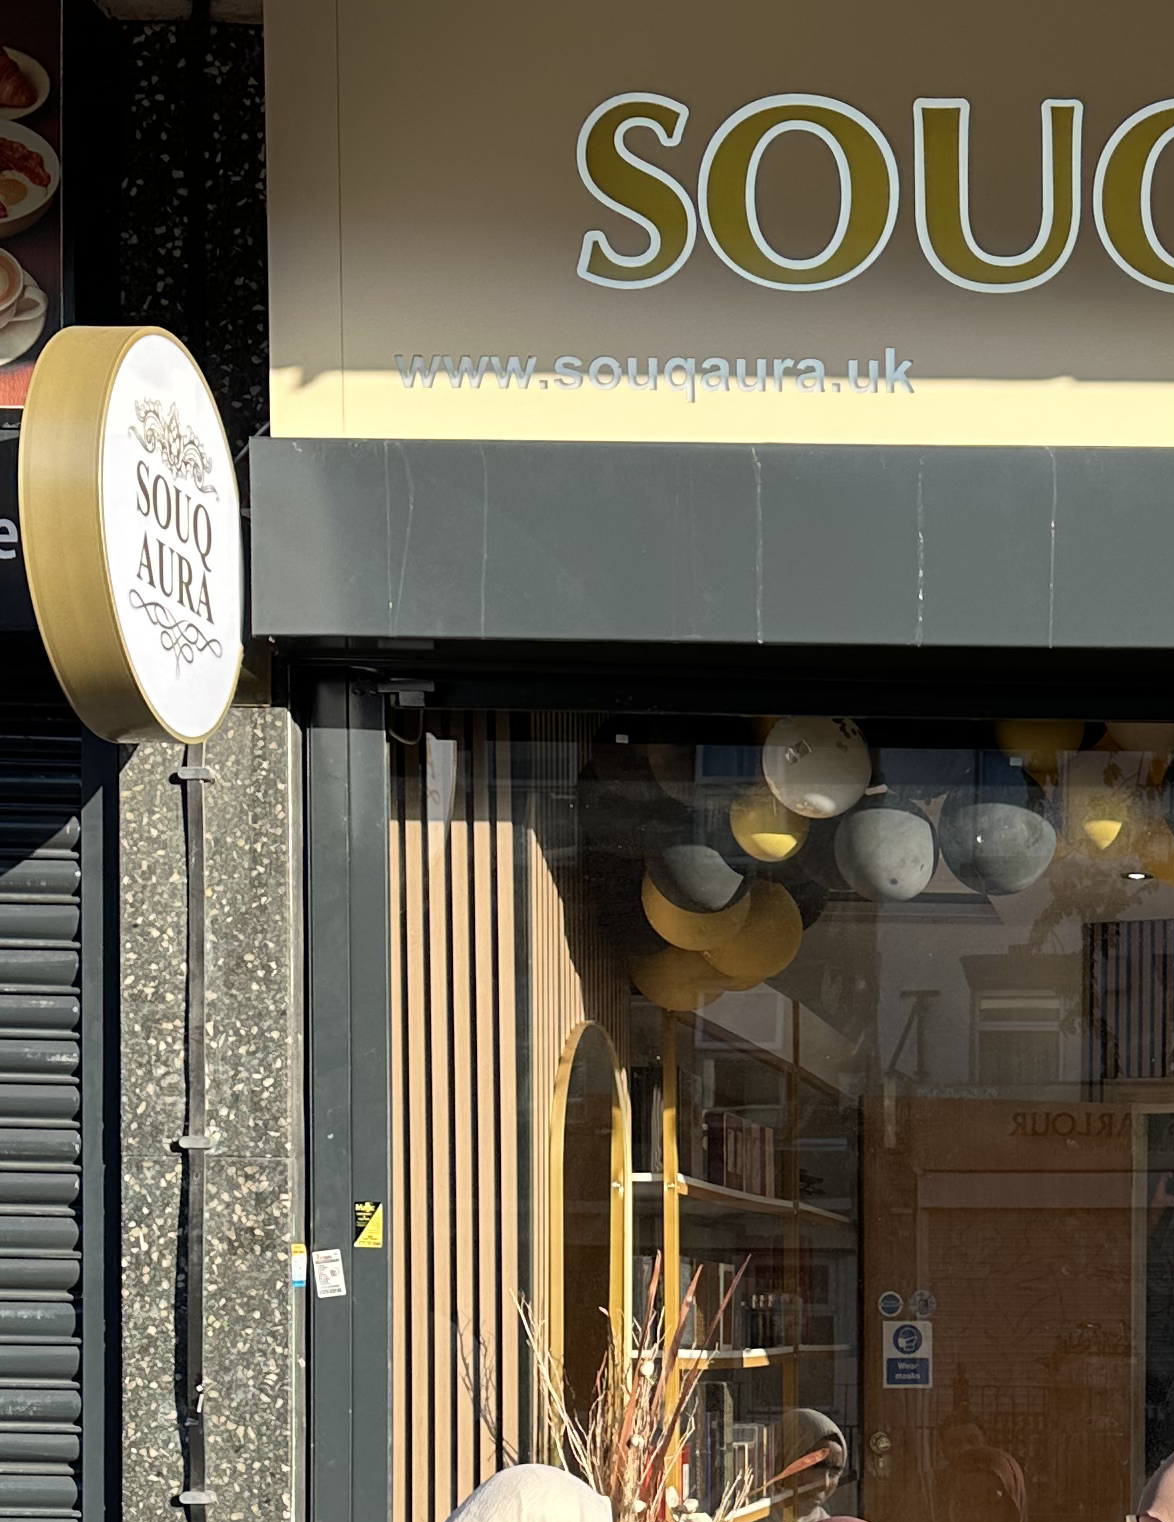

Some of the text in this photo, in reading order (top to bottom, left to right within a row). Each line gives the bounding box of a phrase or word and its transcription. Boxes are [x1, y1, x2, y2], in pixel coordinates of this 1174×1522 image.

[394, 347, 915, 403] www.souqaura.uk
[136, 460, 212, 573] SOUQ
[136, 529, 215, 625] AURA
